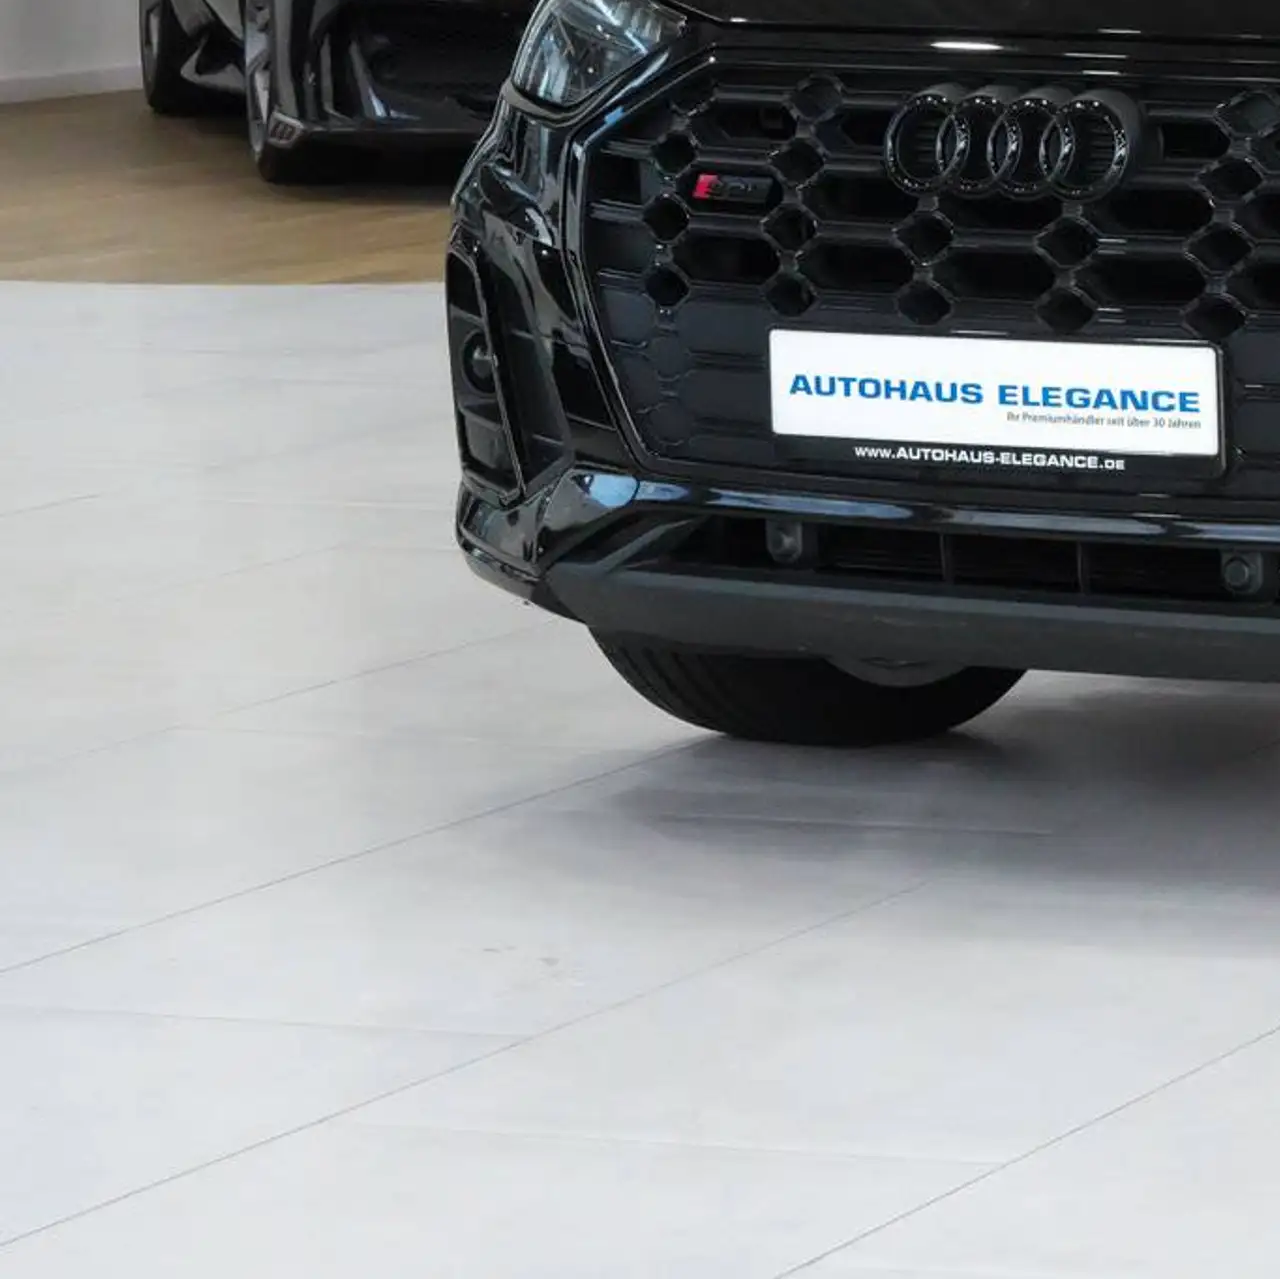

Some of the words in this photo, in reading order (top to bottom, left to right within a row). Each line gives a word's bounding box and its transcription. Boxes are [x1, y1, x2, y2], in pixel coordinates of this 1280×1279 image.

[789, 373, 984, 404] AUTOHAUS
[998, 384, 1201, 413] ELEGANCE
[1022, 412, 1104, 426] Premiumhändler
[1106, 416, 1125, 427] seit
[1127, 415, 1150, 428] über
[1153, 417, 1166, 429] 30
[1168, 418, 1202, 430] Jahren
